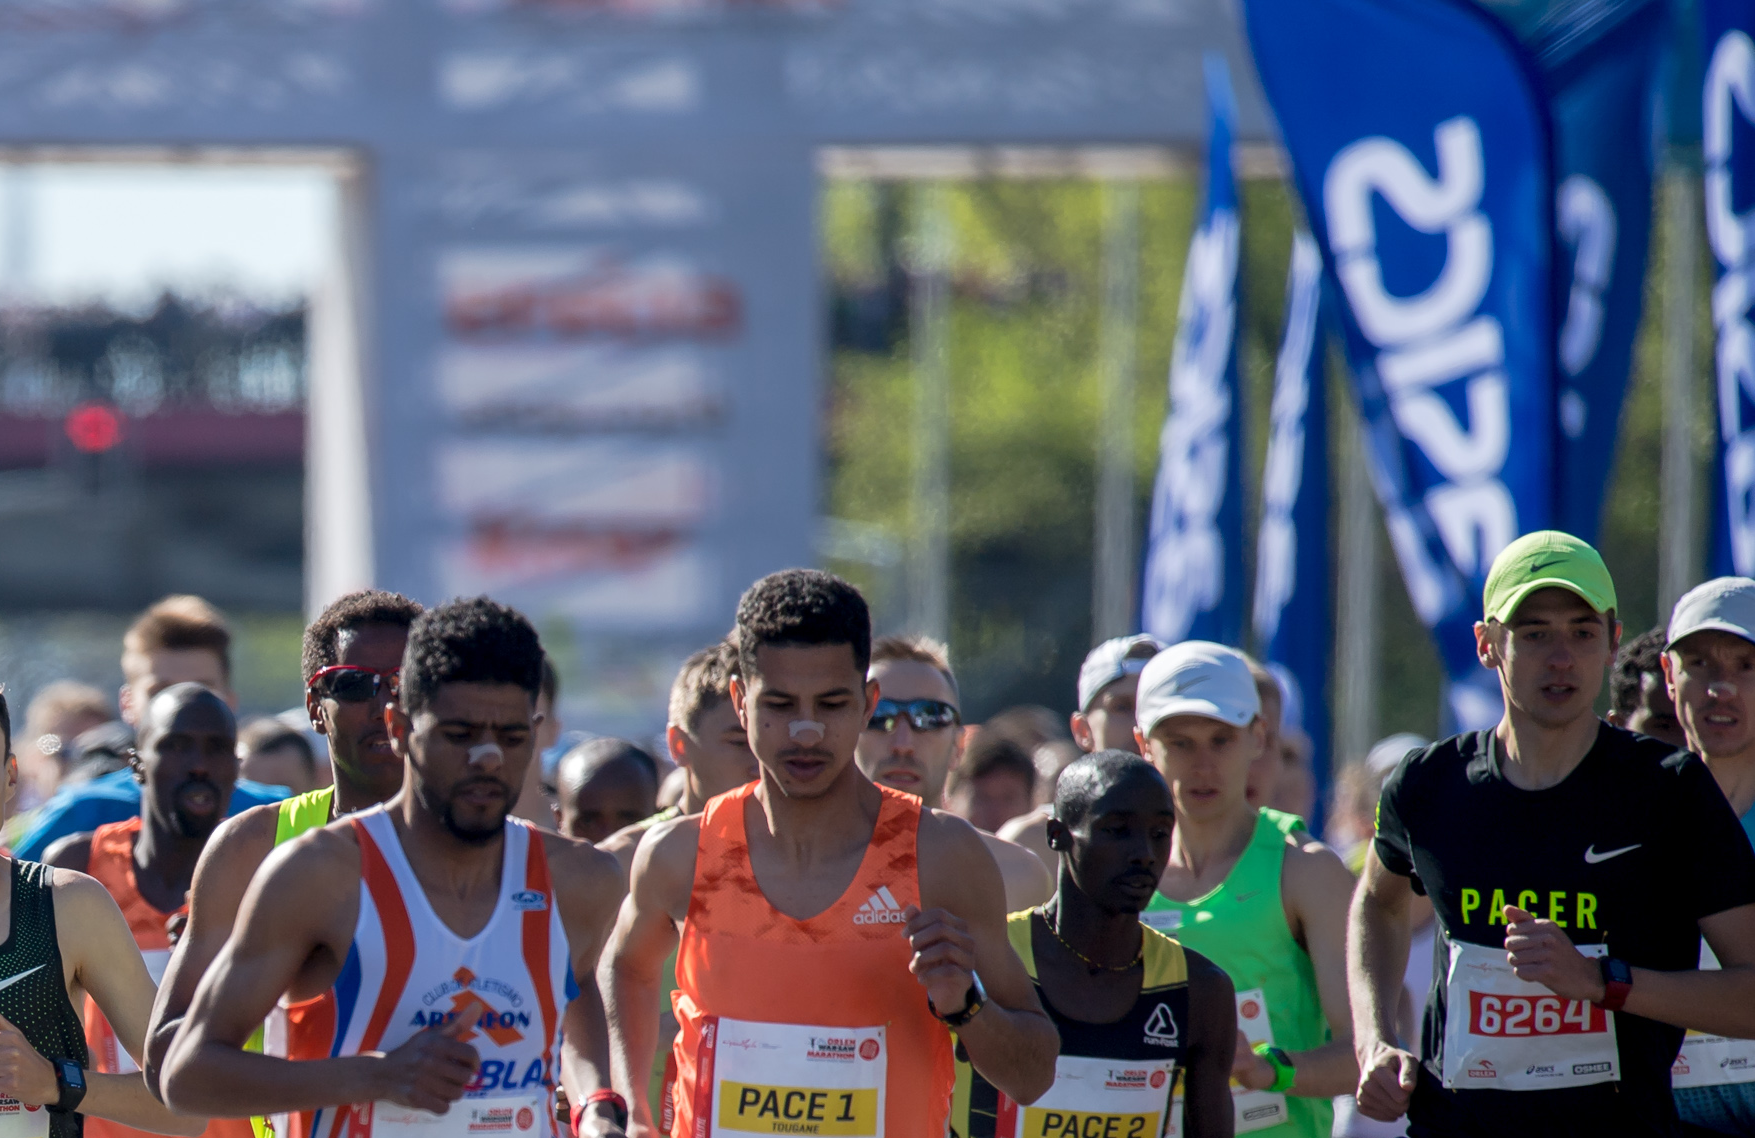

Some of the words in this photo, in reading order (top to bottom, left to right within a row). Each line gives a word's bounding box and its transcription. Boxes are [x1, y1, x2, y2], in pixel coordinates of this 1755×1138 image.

[1461, 887, 1598, 930] PACER
[1479, 995, 1591, 1035] 6264
[737, 1087, 828, 1122] PACE
[836, 1092, 856, 1122] 1
[772, 1121, 820, 1135] TOUGANE
